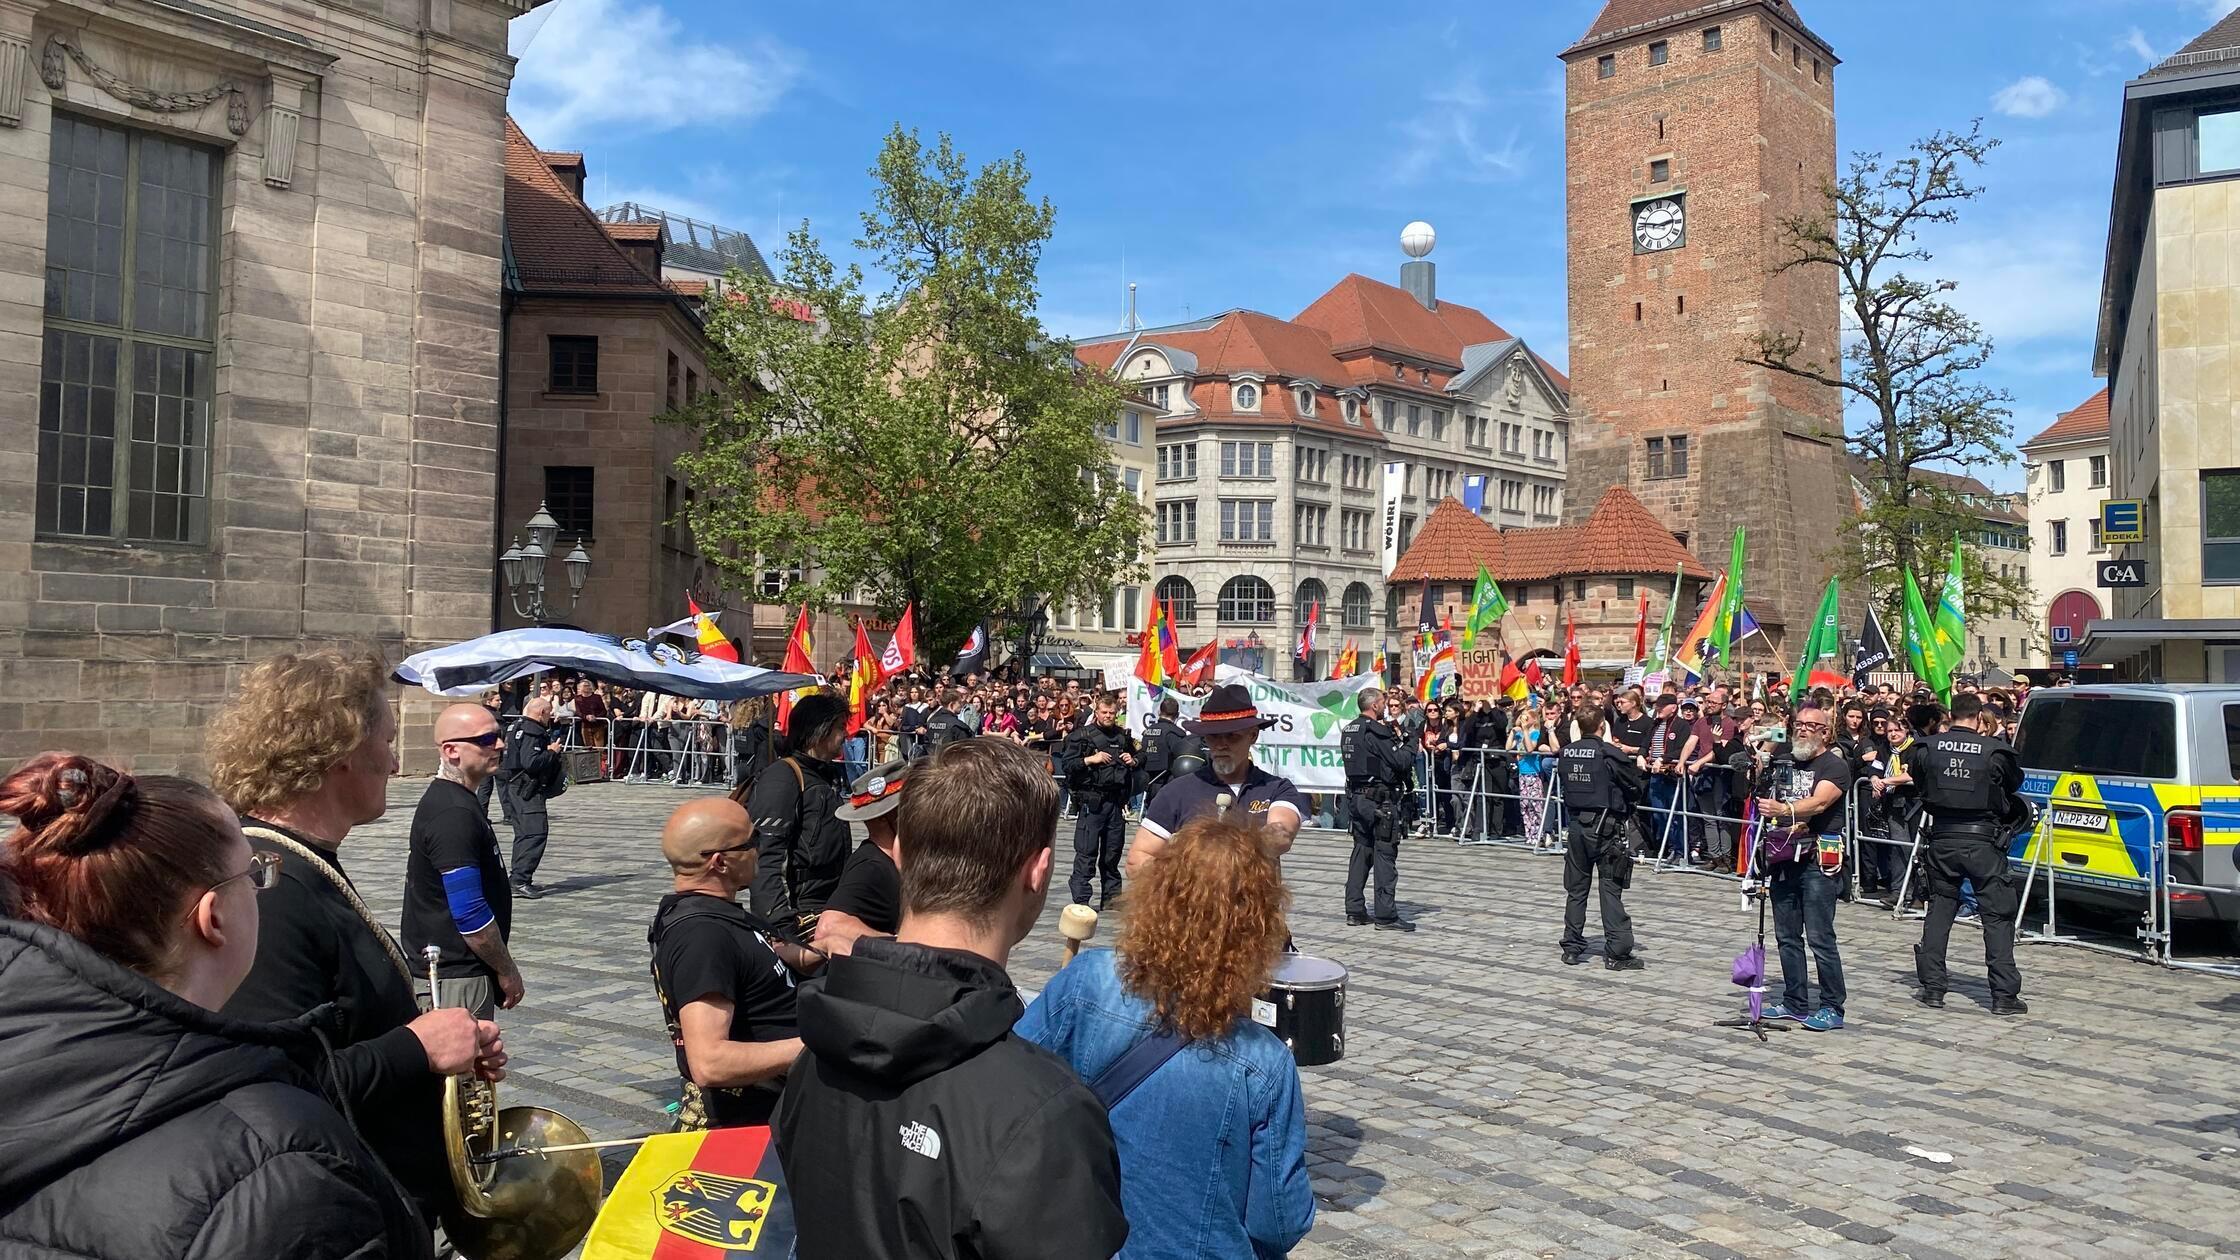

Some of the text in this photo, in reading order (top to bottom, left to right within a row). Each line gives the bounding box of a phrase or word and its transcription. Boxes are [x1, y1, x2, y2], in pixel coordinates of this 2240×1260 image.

[1384, 496, 1397, 550] WÖHRL
[2105, 533, 2139, 541] EDEKA
[2103, 565, 2139, 583] C&A
[2055, 628, 2068, 641] U
[1462, 649, 1496, 664] FIGHT
[1462, 663, 1495, 678] NAZI
[1463, 678, 1500, 696] SCUM
[1563, 748, 1595, 759] POLIZEI
[1937, 740, 1982, 754] POLIZEI
[1573, 764, 1583, 773] BY
[1950, 758, 1964, 768] BY
[1943, 767, 1971, 779] 4412
[2023, 780, 2050, 793] OLIZEI
[2083, 815, 2102, 827] 349
[912, 1120, 928, 1134] THE
[899, 1124, 924, 1146] NORTH
[901, 1135, 921, 1153] FACE
